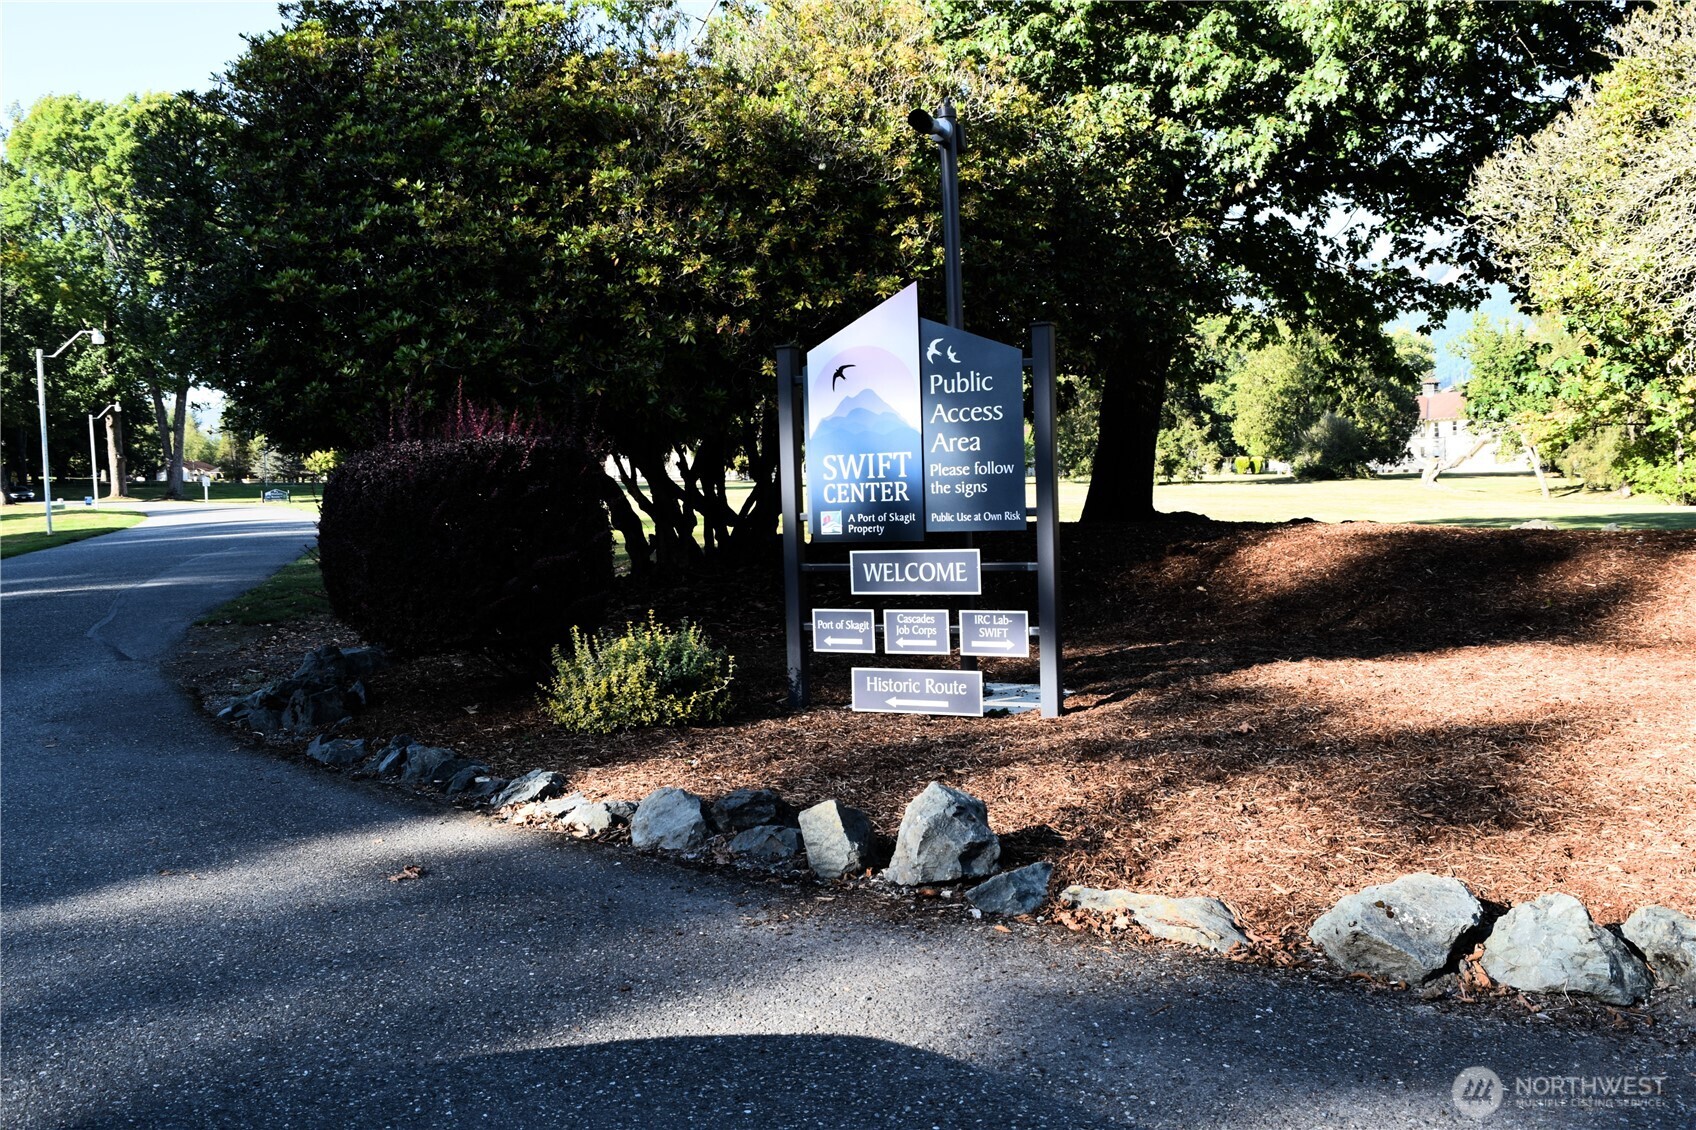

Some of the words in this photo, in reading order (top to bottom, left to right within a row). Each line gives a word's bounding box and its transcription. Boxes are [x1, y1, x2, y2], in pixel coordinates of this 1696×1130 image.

[930, 370, 994, 395] Public
[929, 403, 1004, 424] Access
[930, 432, 981, 453] Area
[822, 452, 912, 480] SWIFT
[929, 463, 970, 477] Please
[974, 460, 1015, 475] follow
[823, 481, 910, 504] CENTER
[930, 481, 951, 495] the
[954, 481, 988, 498] signs
[847, 513, 856, 523] A
[857, 513, 876, 523] Port
[877, 512, 888, 522] of
[888, 512, 916, 525] Skagit
[931, 512, 954, 522] Public
[956, 512, 972, 522] Use
[973, 512, 982, 522] at
[983, 511, 1002, 521] Own
[1004, 510, 1021, 521] Risk
[848, 524, 885, 536] Property
[862, 562, 968, 582] WELCOME
[817, 619, 834, 630] Port
[835, 619, 845, 630] of
[845, 619, 870, 634] Skagit
[896, 613, 936, 624] Cascades
[974, 614, 991, 625] IRC
[993, 614, 1013, 625] Lab-
[896, 624, 910, 636] Job
[911, 624, 937, 638] Corps
[978, 627, 1009, 638] SWIFT
[866, 676, 921, 694] Historic
[925, 678, 968, 695] Route
